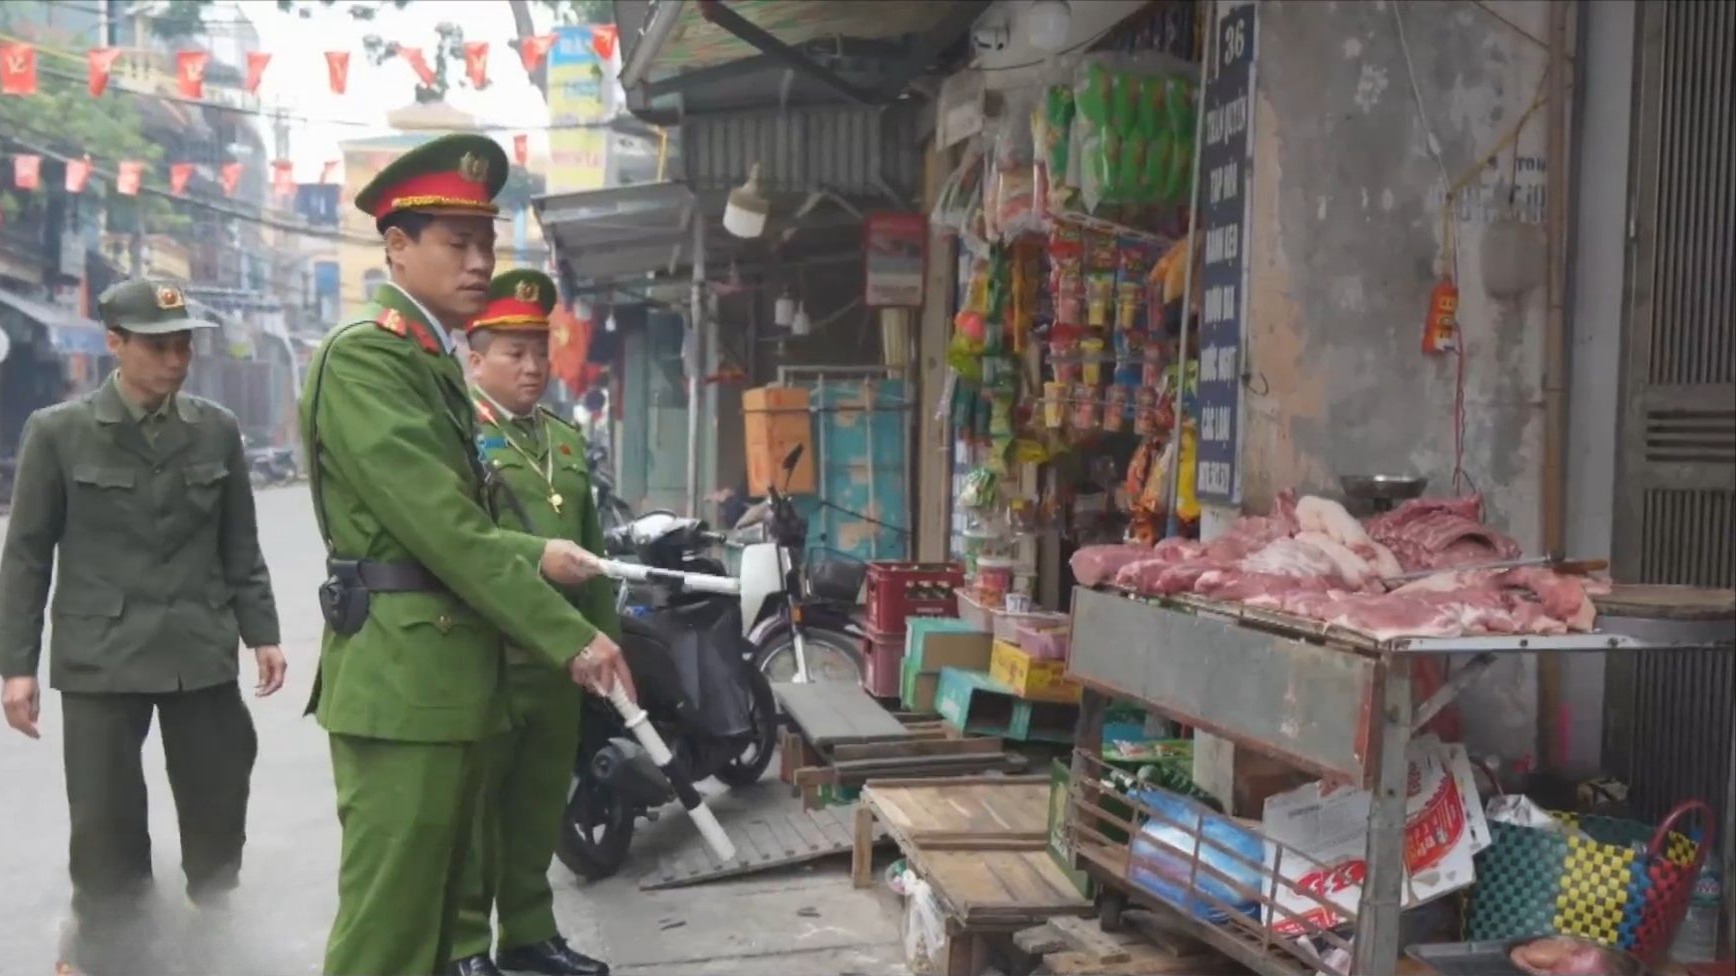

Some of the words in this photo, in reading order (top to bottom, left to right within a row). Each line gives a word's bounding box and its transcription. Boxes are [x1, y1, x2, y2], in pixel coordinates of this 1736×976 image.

[1224, 18, 1245, 65] 36
[1205, 221, 1224, 264] BÁNH
[1224, 223, 1238, 266] KẸO
[1201, 400, 1215, 441] CÁC
[1215, 405, 1231, 450] LOẠI
